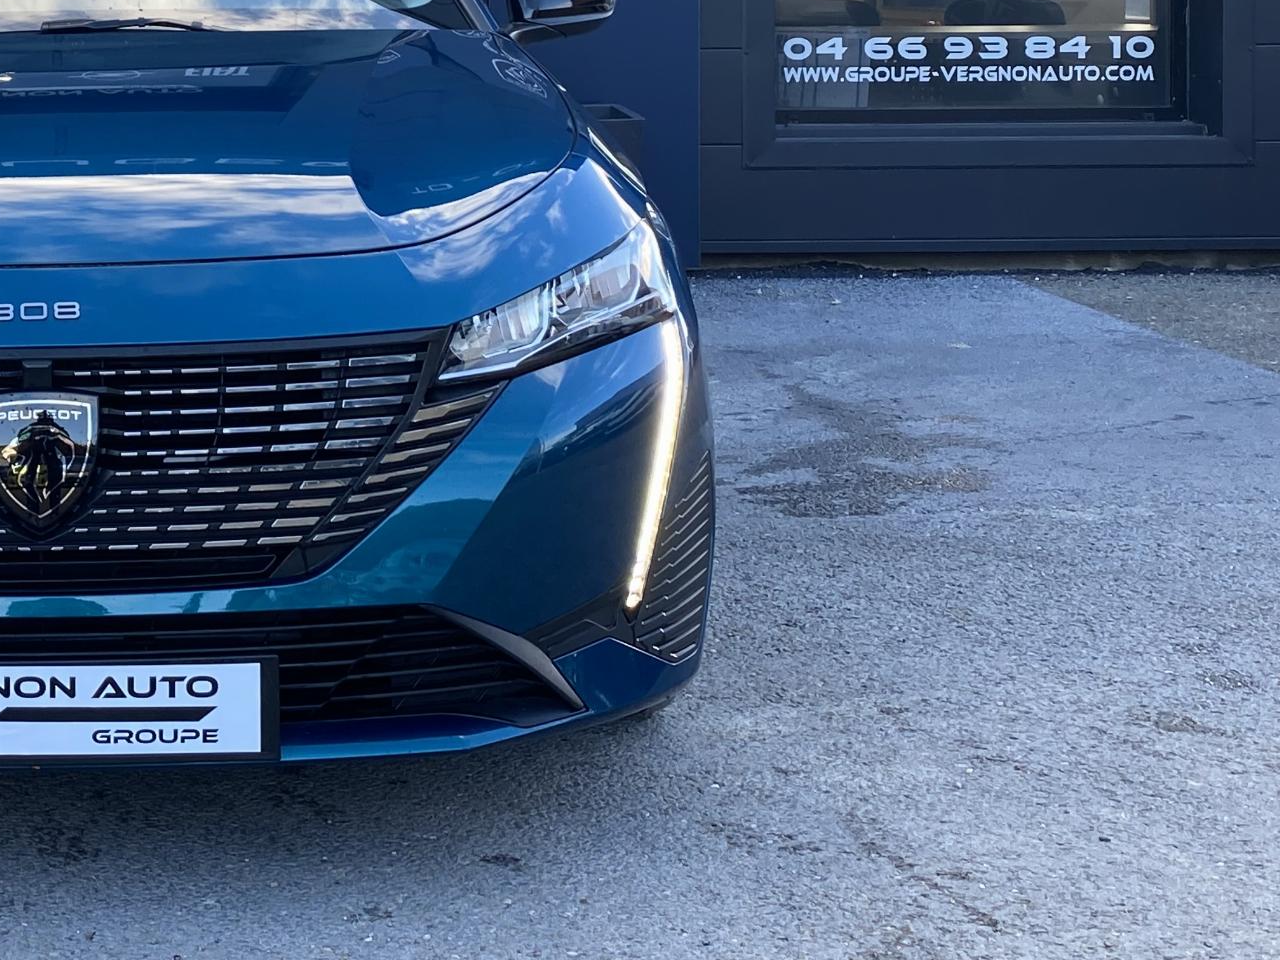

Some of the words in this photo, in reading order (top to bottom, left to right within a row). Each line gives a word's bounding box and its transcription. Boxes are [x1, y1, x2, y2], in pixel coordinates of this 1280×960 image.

[783, 36, 848, 61] 04
[864, 36, 928, 60] 66
[943, 36, 1009, 60] 93
[1024, 35, 1091, 60] 84
[1108, 35, 1155, 59] 10
[783, 65, 1155, 83] WWW.GROUPE-VERGNONAUTO.COM
[91, 674, 219, 700] AUTO
[91, 728, 220, 744] GROUPE
